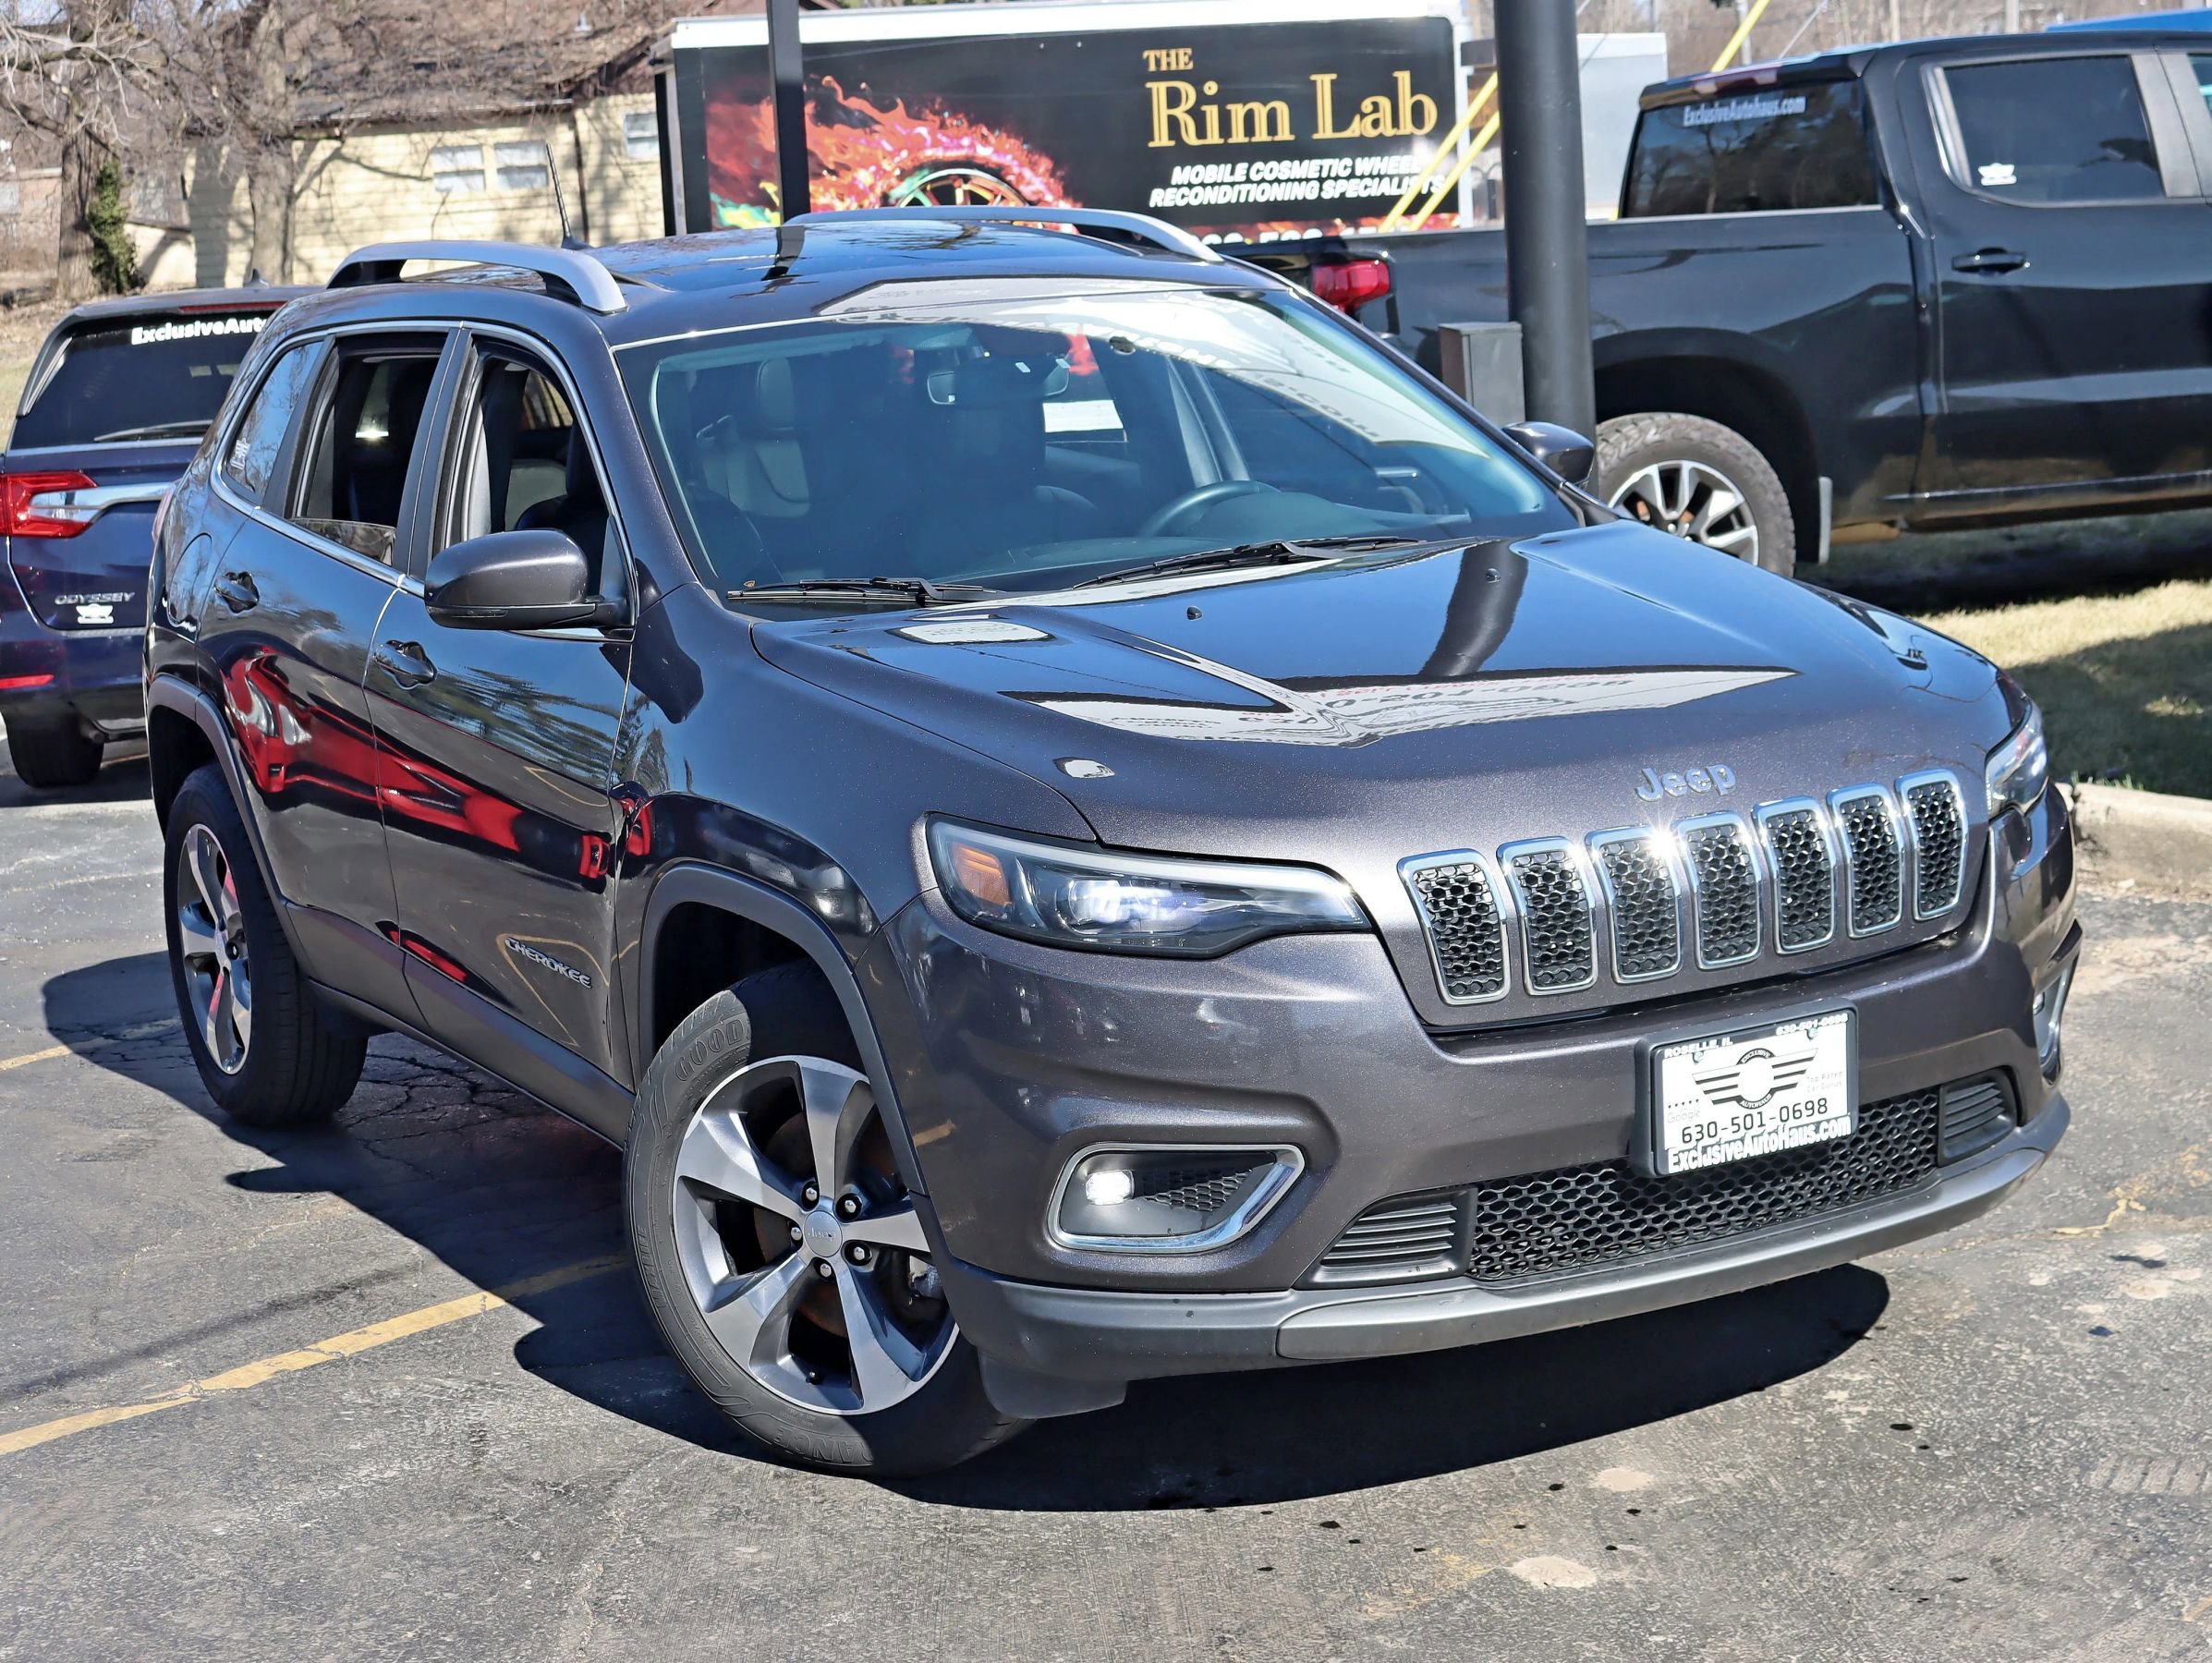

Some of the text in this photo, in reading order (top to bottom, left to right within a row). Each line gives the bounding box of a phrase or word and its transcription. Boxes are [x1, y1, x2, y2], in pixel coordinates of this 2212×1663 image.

[1142, 47, 1195, 72] THE
[1144, 69, 1439, 148] Rim Lab
[1171, 154, 1423, 186] MOBILE COSMETIC WHEEL
[1149, 179, 1320, 208] RECONDITIONING
[55, 591, 136, 605] ODYSSEY
[1635, 764, 1736, 802] Jeep
[504, 937, 592, 989] CHEROKEE
[1720, 1036, 1734, 1048] IL
[1682, 1098, 1829, 1145] 630-501-0698
[1668, 1114, 1852, 1173] ExclusiveAutoHaus.com
